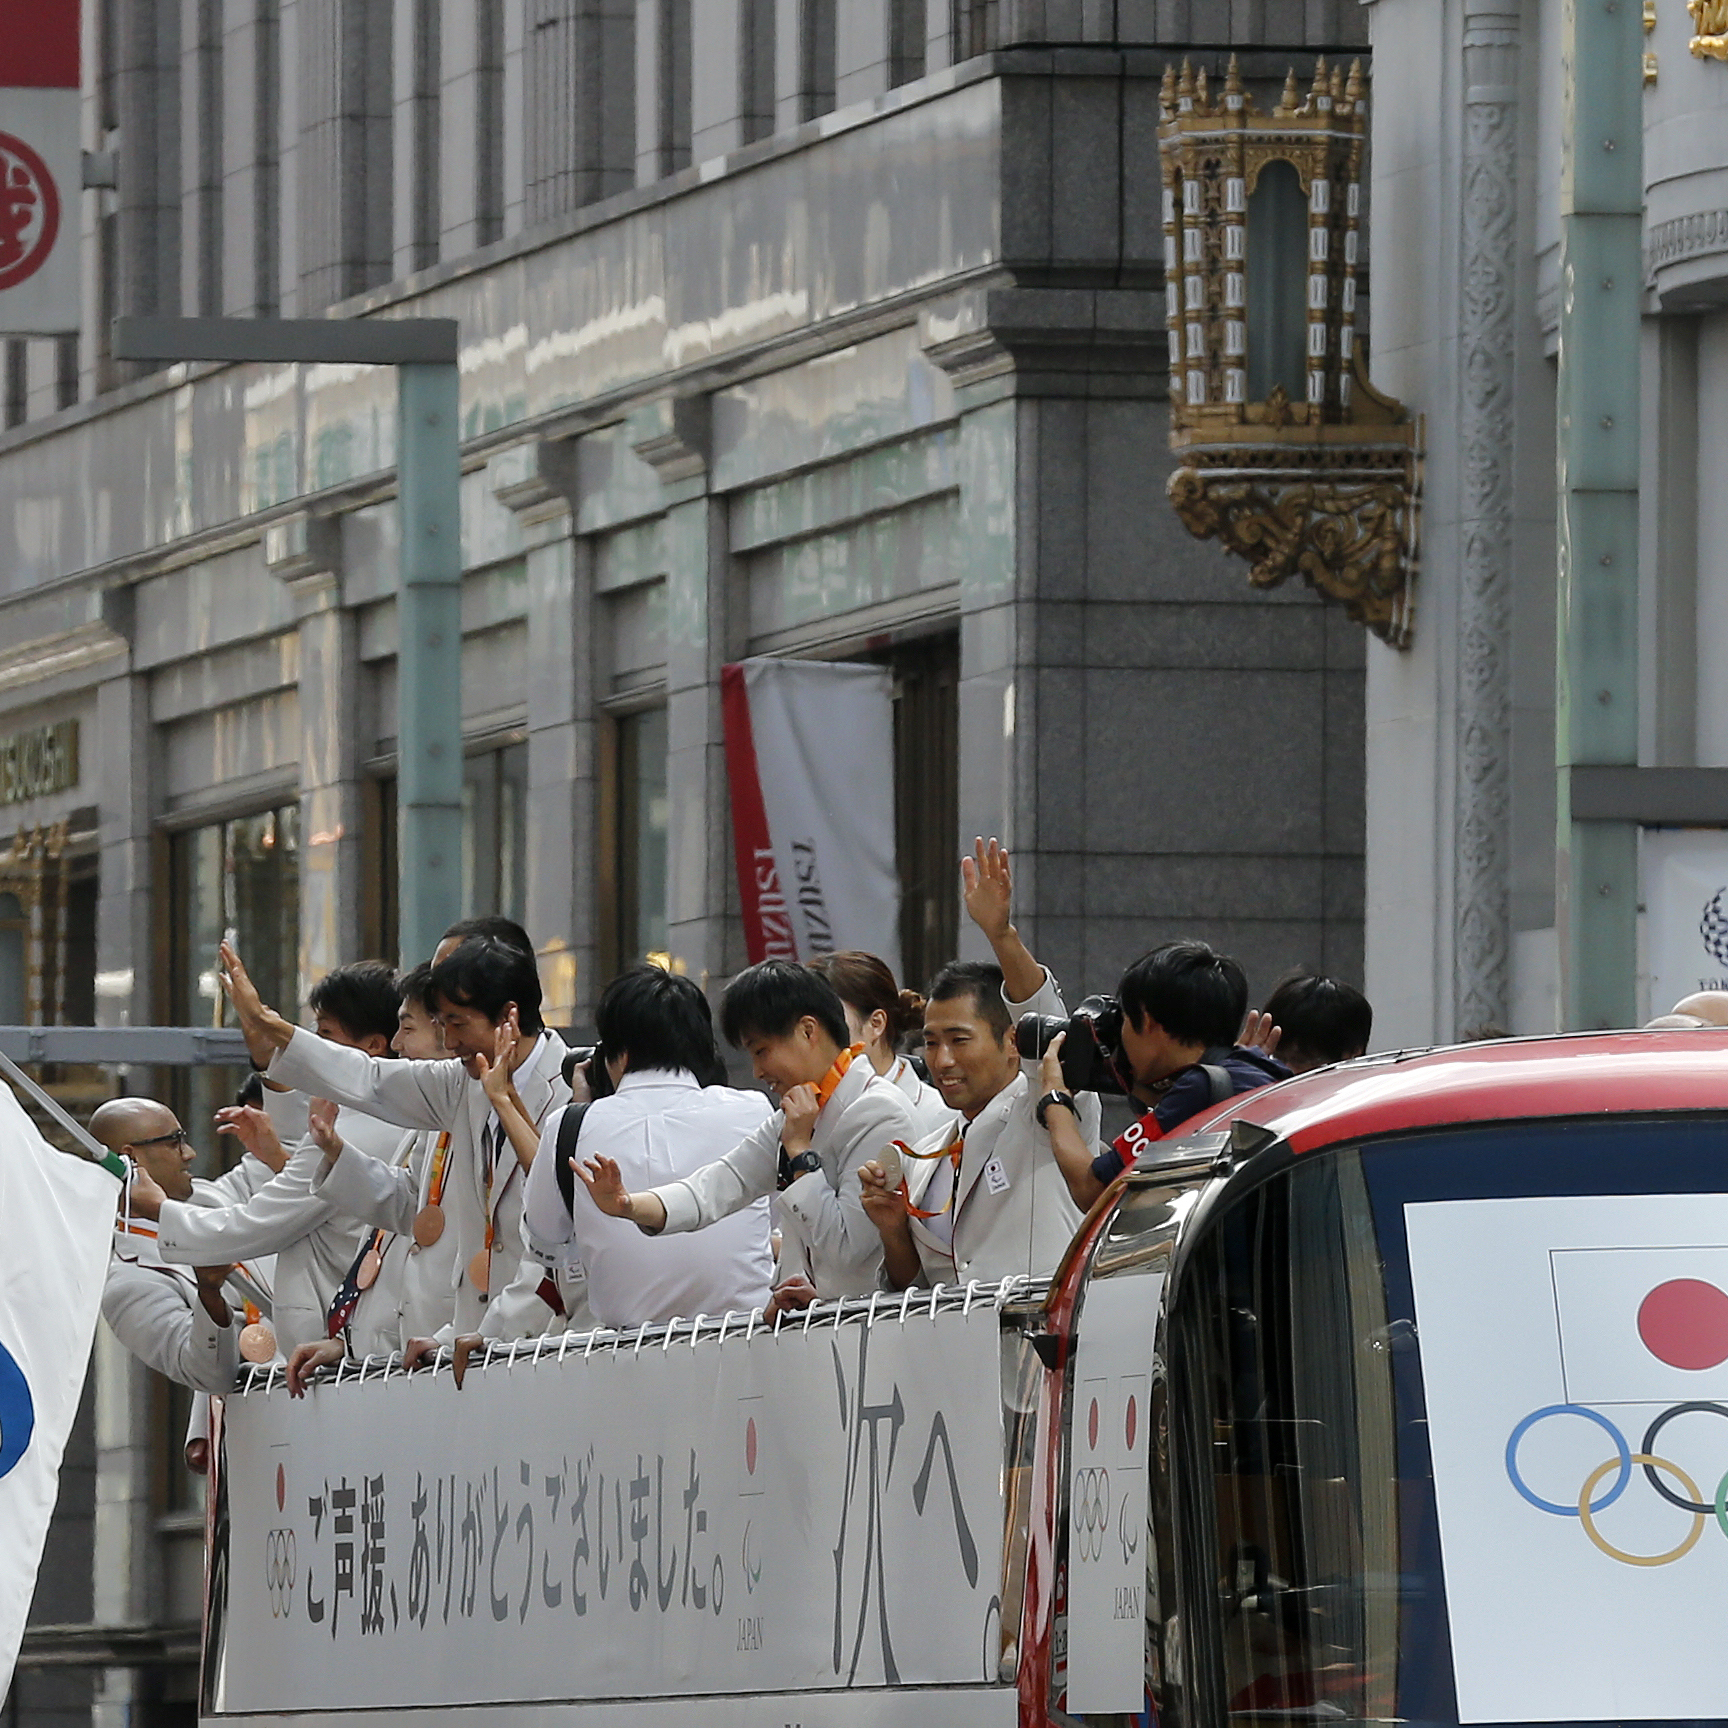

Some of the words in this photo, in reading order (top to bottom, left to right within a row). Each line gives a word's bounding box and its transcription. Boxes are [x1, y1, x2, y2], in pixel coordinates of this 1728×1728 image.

[308, 1442, 724, 1641] ご声援、ありがとうございました。
[1113, 1586, 1140, 1620] JAPAN
[736, 1616, 763, 1651] JAPAN
